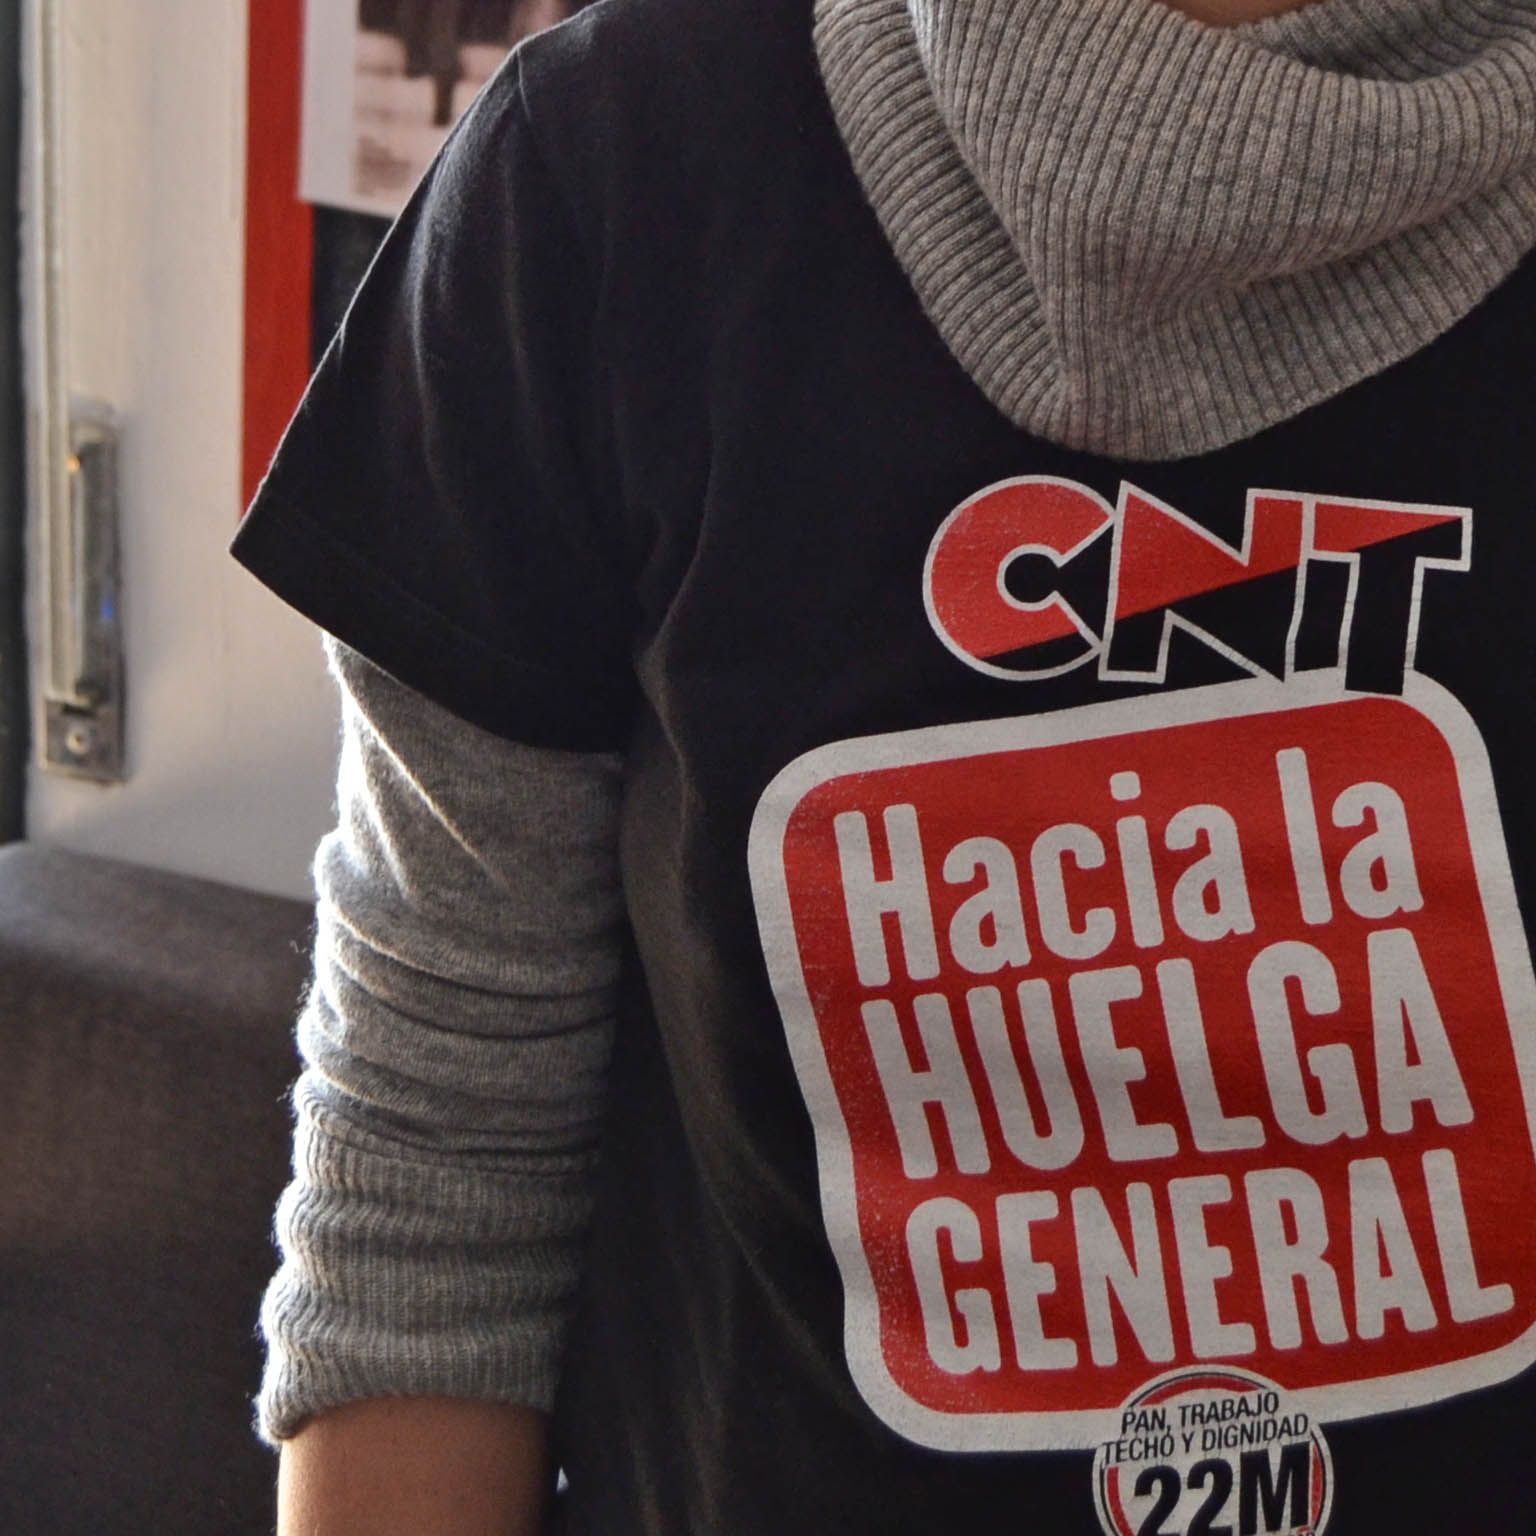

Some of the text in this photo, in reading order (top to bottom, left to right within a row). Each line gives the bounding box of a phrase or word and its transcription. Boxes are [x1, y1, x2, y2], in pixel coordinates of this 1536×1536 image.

[923, 474, 1473, 696] CNT
[833, 746, 1424, 987] Hacia la
[861, 926, 1474, 1181] HUELGA
[905, 1148, 1515, 1376] GENERAL
[1101, 1413, 1310, 1465] TECHO Y DIGNIDAD
[1120, 1391, 1280, 1434] PAN, TRABAJO
[1133, 1440, 1311, 1536] 22M
